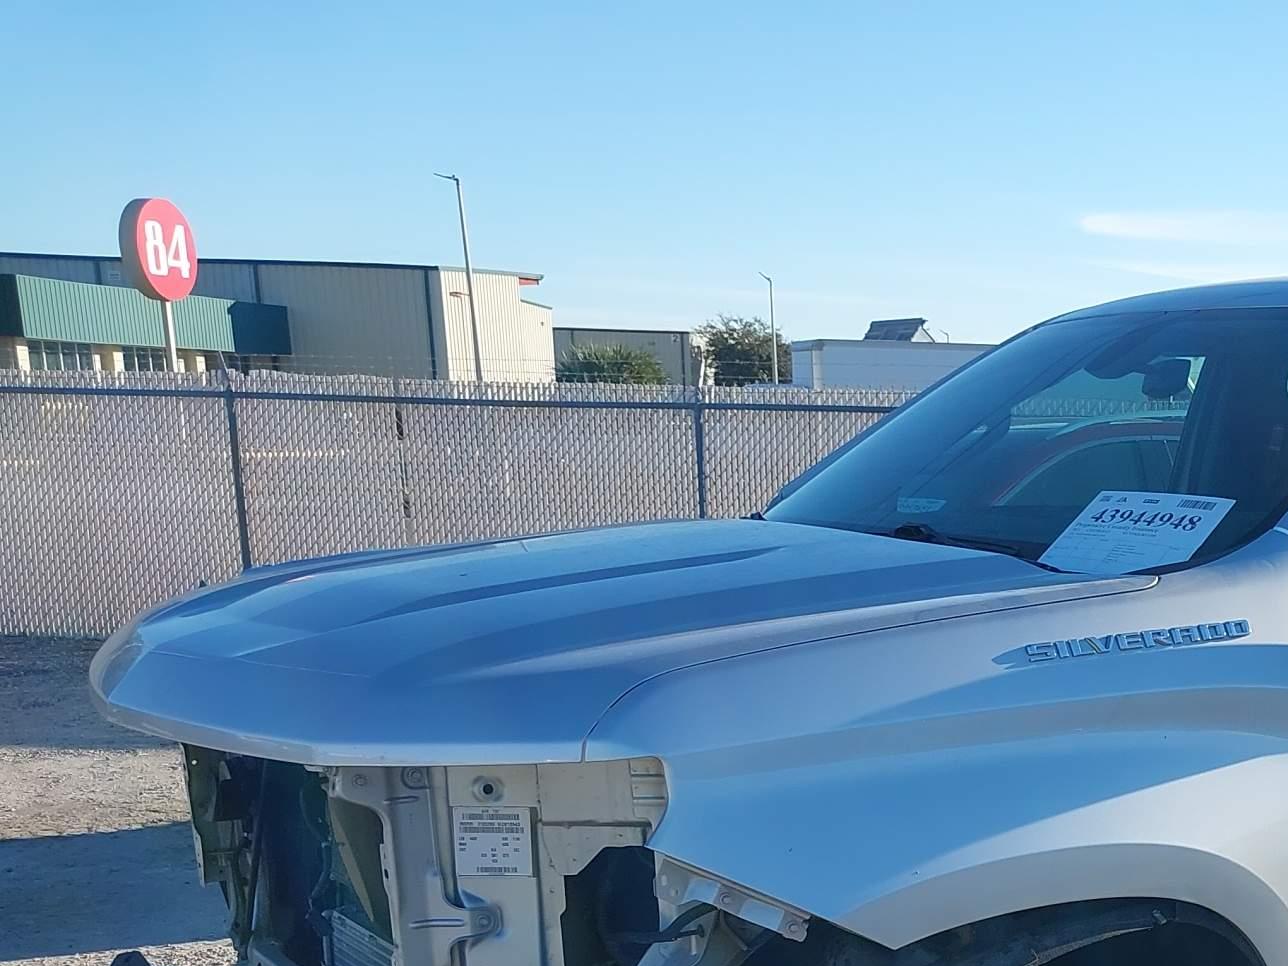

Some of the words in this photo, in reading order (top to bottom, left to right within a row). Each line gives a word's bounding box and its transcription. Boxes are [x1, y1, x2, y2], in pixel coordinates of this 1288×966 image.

[144, 219, 191, 279] 84
[1091, 508, 1203, 532] 43944948
[1026, 618, 1253, 663] SILVERADO
